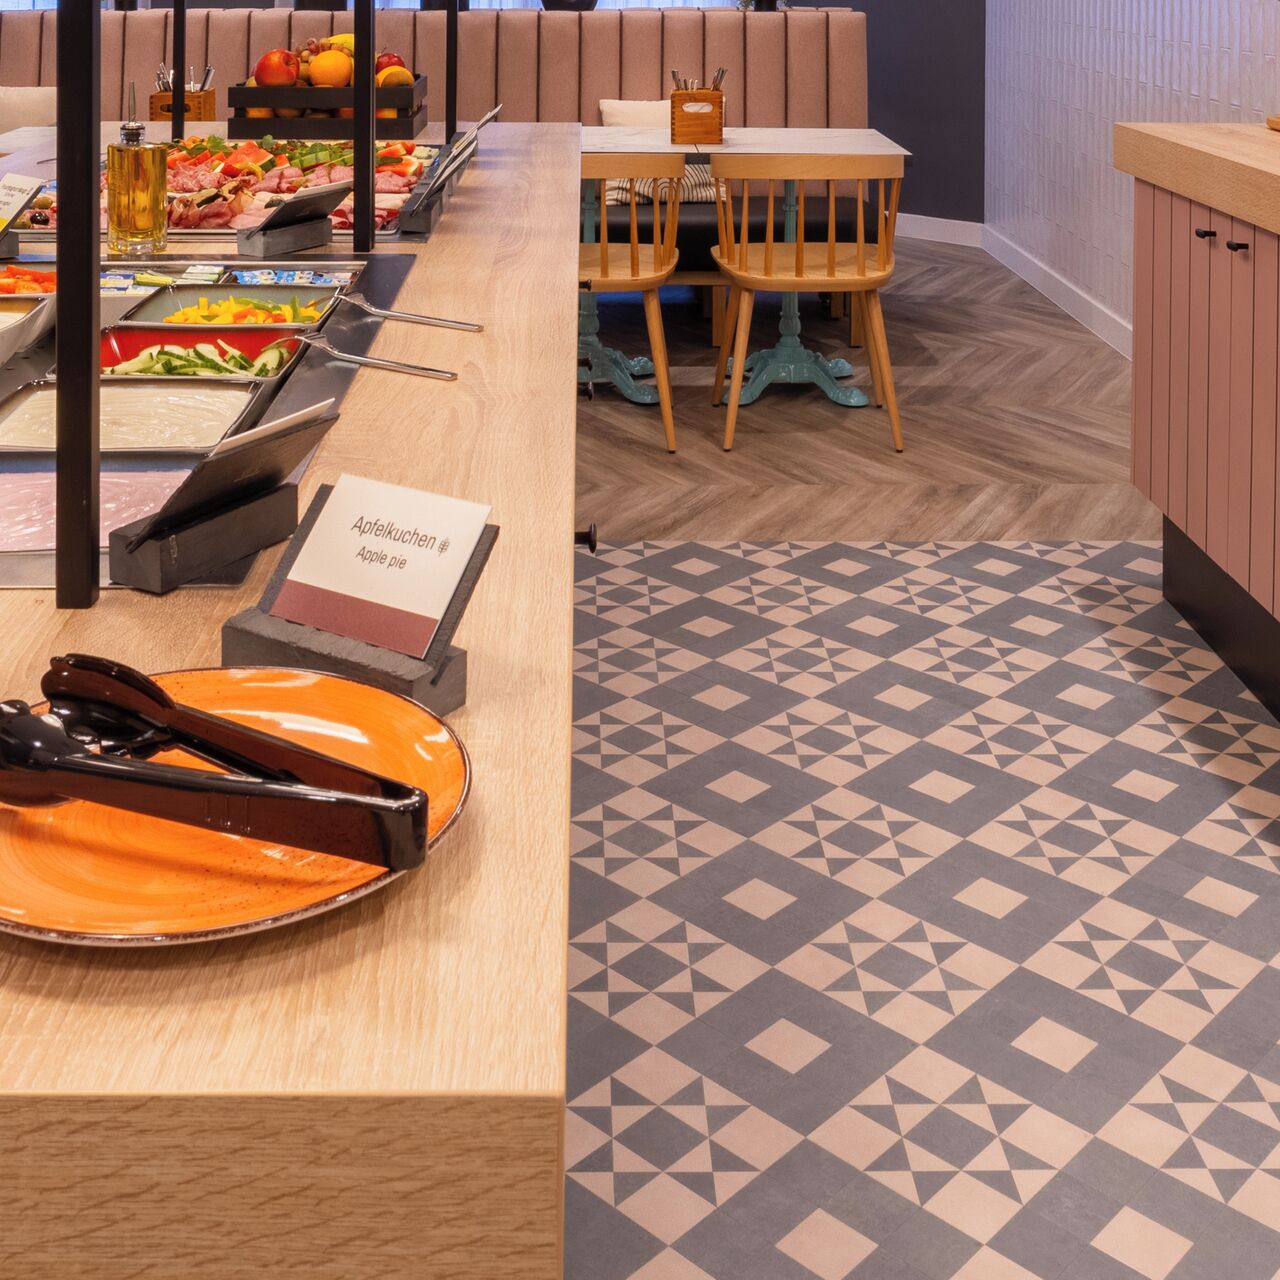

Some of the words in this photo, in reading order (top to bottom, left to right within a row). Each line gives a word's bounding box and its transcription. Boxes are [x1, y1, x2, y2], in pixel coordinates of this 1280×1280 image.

[351, 515, 437, 550] Apfelkuchen
[355, 545, 388, 565] Apple
[386, 554, 407, 569] pie
